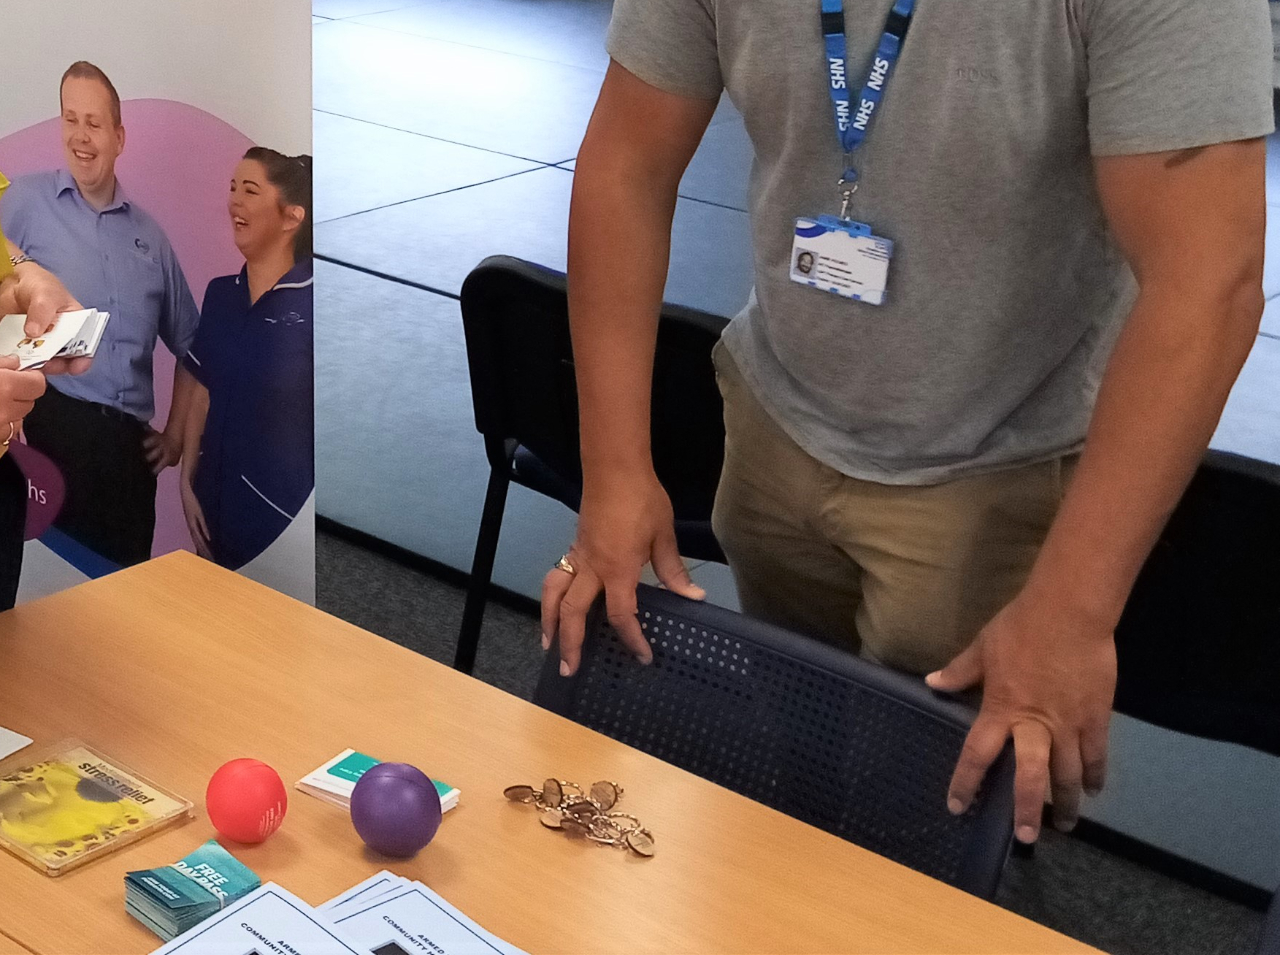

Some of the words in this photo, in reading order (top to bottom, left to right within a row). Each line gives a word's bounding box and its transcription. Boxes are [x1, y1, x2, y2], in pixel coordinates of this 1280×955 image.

[829, 58, 846, 89] NHS
[868, 57, 889, 91] NHS
[853, 98, 874, 130] NHS
[78, 762, 119, 786] stress
[117, 783, 155, 804] relief
[194, 863, 229, 886] FREE
[382, 915, 428, 954] COMMUNITY
[417, 934, 445, 954] ARMED
